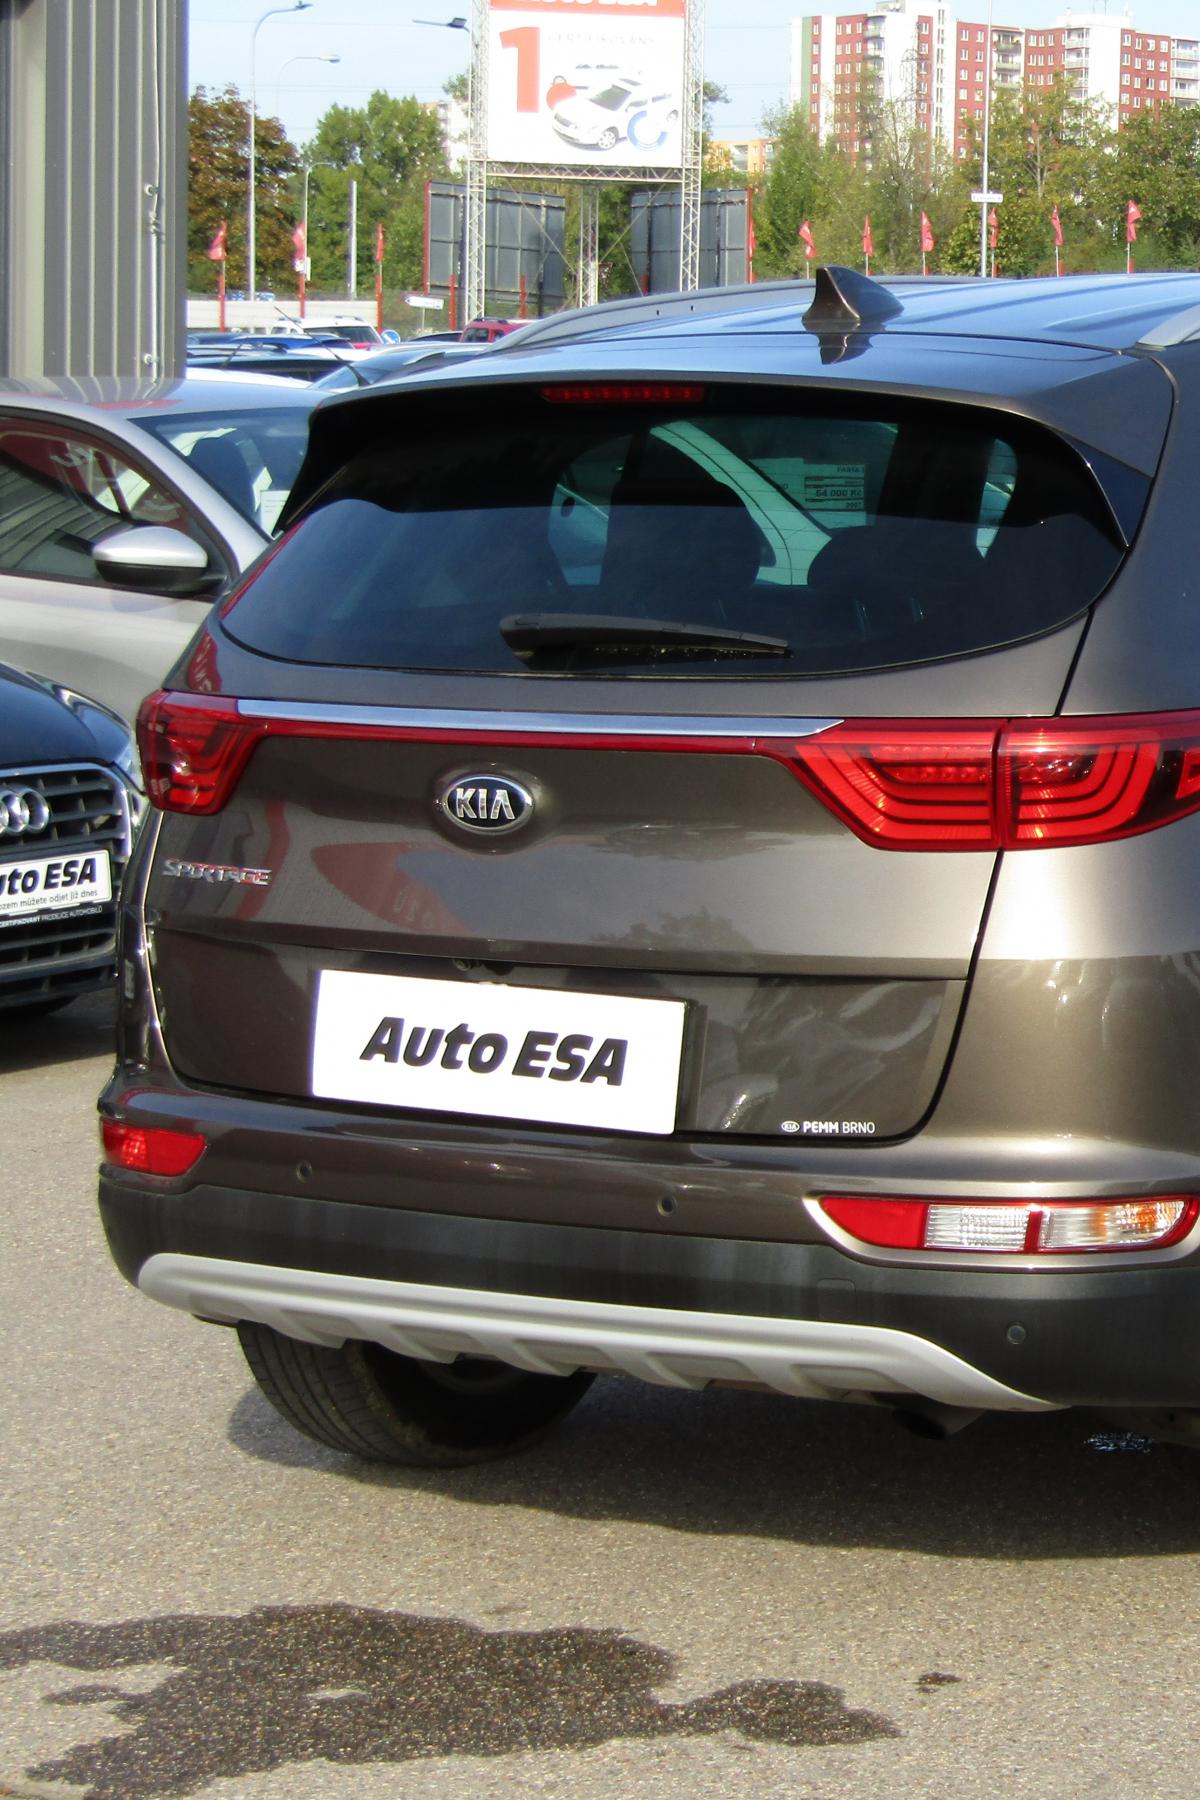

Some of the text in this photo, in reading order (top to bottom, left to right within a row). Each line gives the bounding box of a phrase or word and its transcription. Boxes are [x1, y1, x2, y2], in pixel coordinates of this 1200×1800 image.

[499, 26, 540, 113] 1
[455, 787, 515, 820] KIA
[43, 857, 97, 890] ESA
[81, 889, 98, 898] dnes
[359, 1016, 628, 1087] Auto ESA
[803, 1121, 839, 1133] PEMM
[842, 1121, 875, 1134] BRNO
